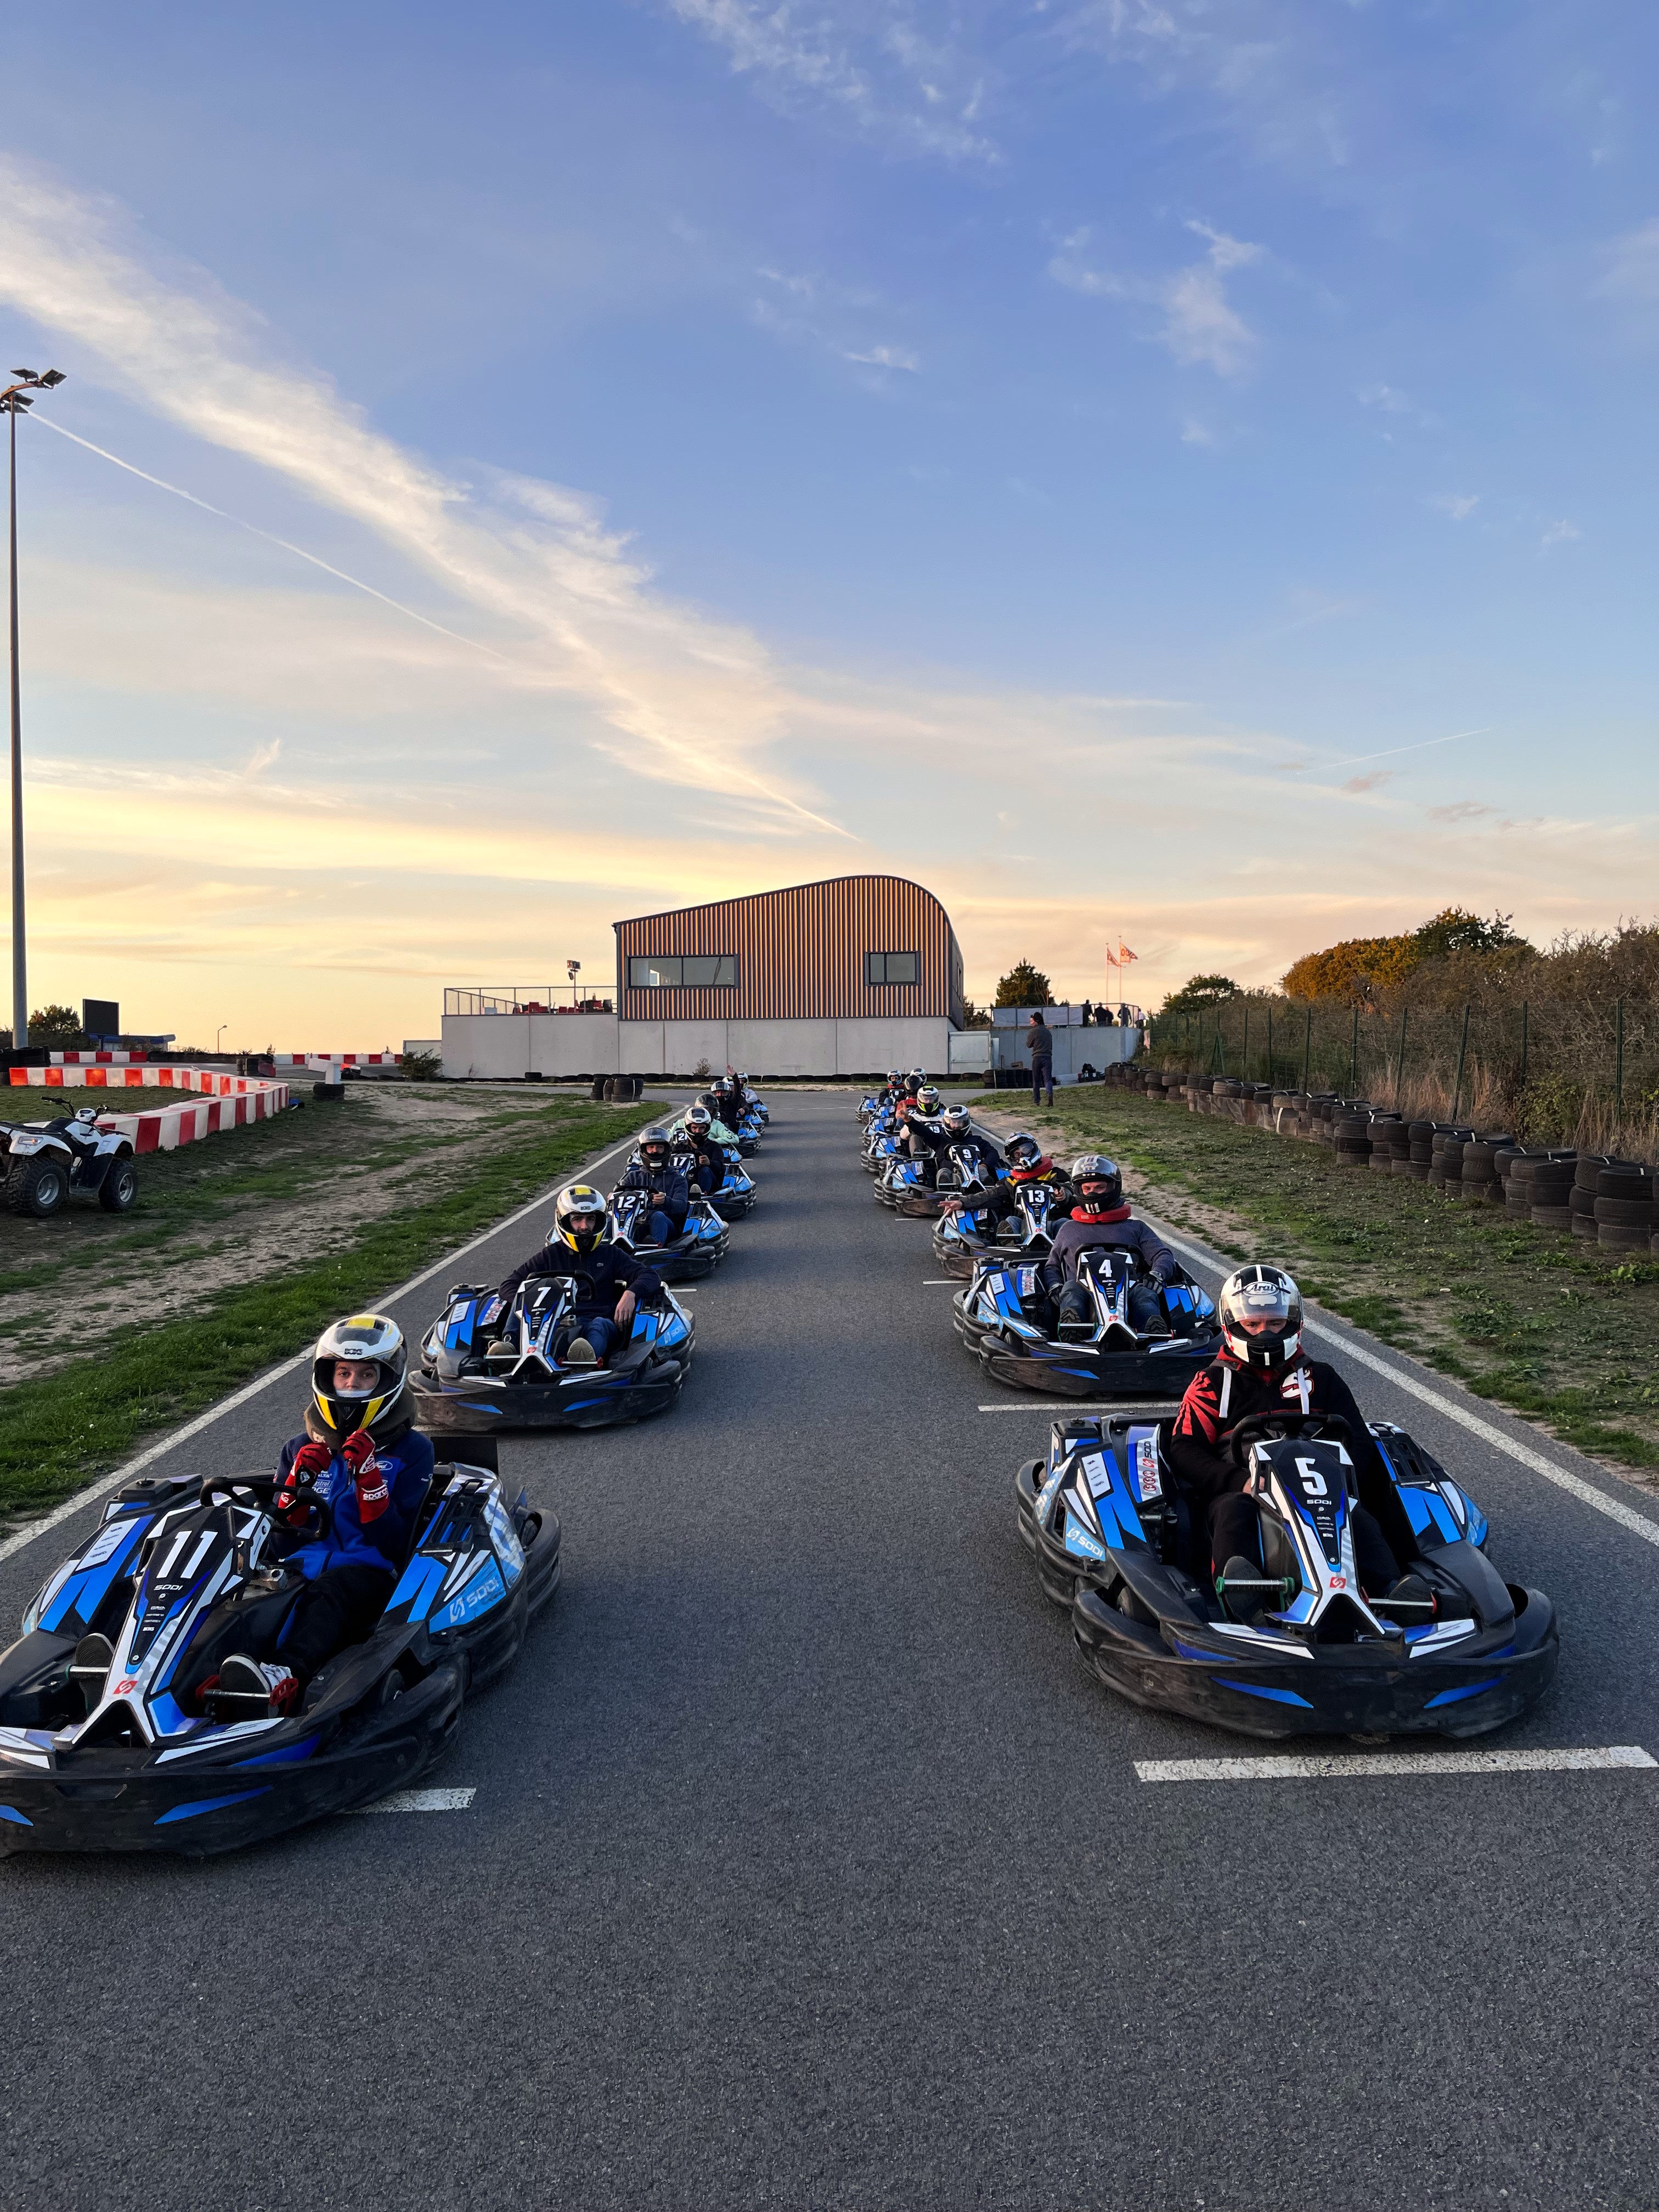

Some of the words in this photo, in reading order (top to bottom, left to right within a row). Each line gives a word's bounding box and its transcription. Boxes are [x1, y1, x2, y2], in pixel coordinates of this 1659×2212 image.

[674, 1157, 687, 1166] 17
[963, 1149, 972, 1159] 9
[618, 1196, 636, 1208] 12
[1028, 1190, 1045, 1203] 13
[1099, 1260, 1112, 1277] 4
[533, 1287, 551, 1307] 7
[1295, 1458, 1328, 1496] 5
[157, 1531, 218, 1578] 11
[1077, 1536, 1103, 1558] SODI
